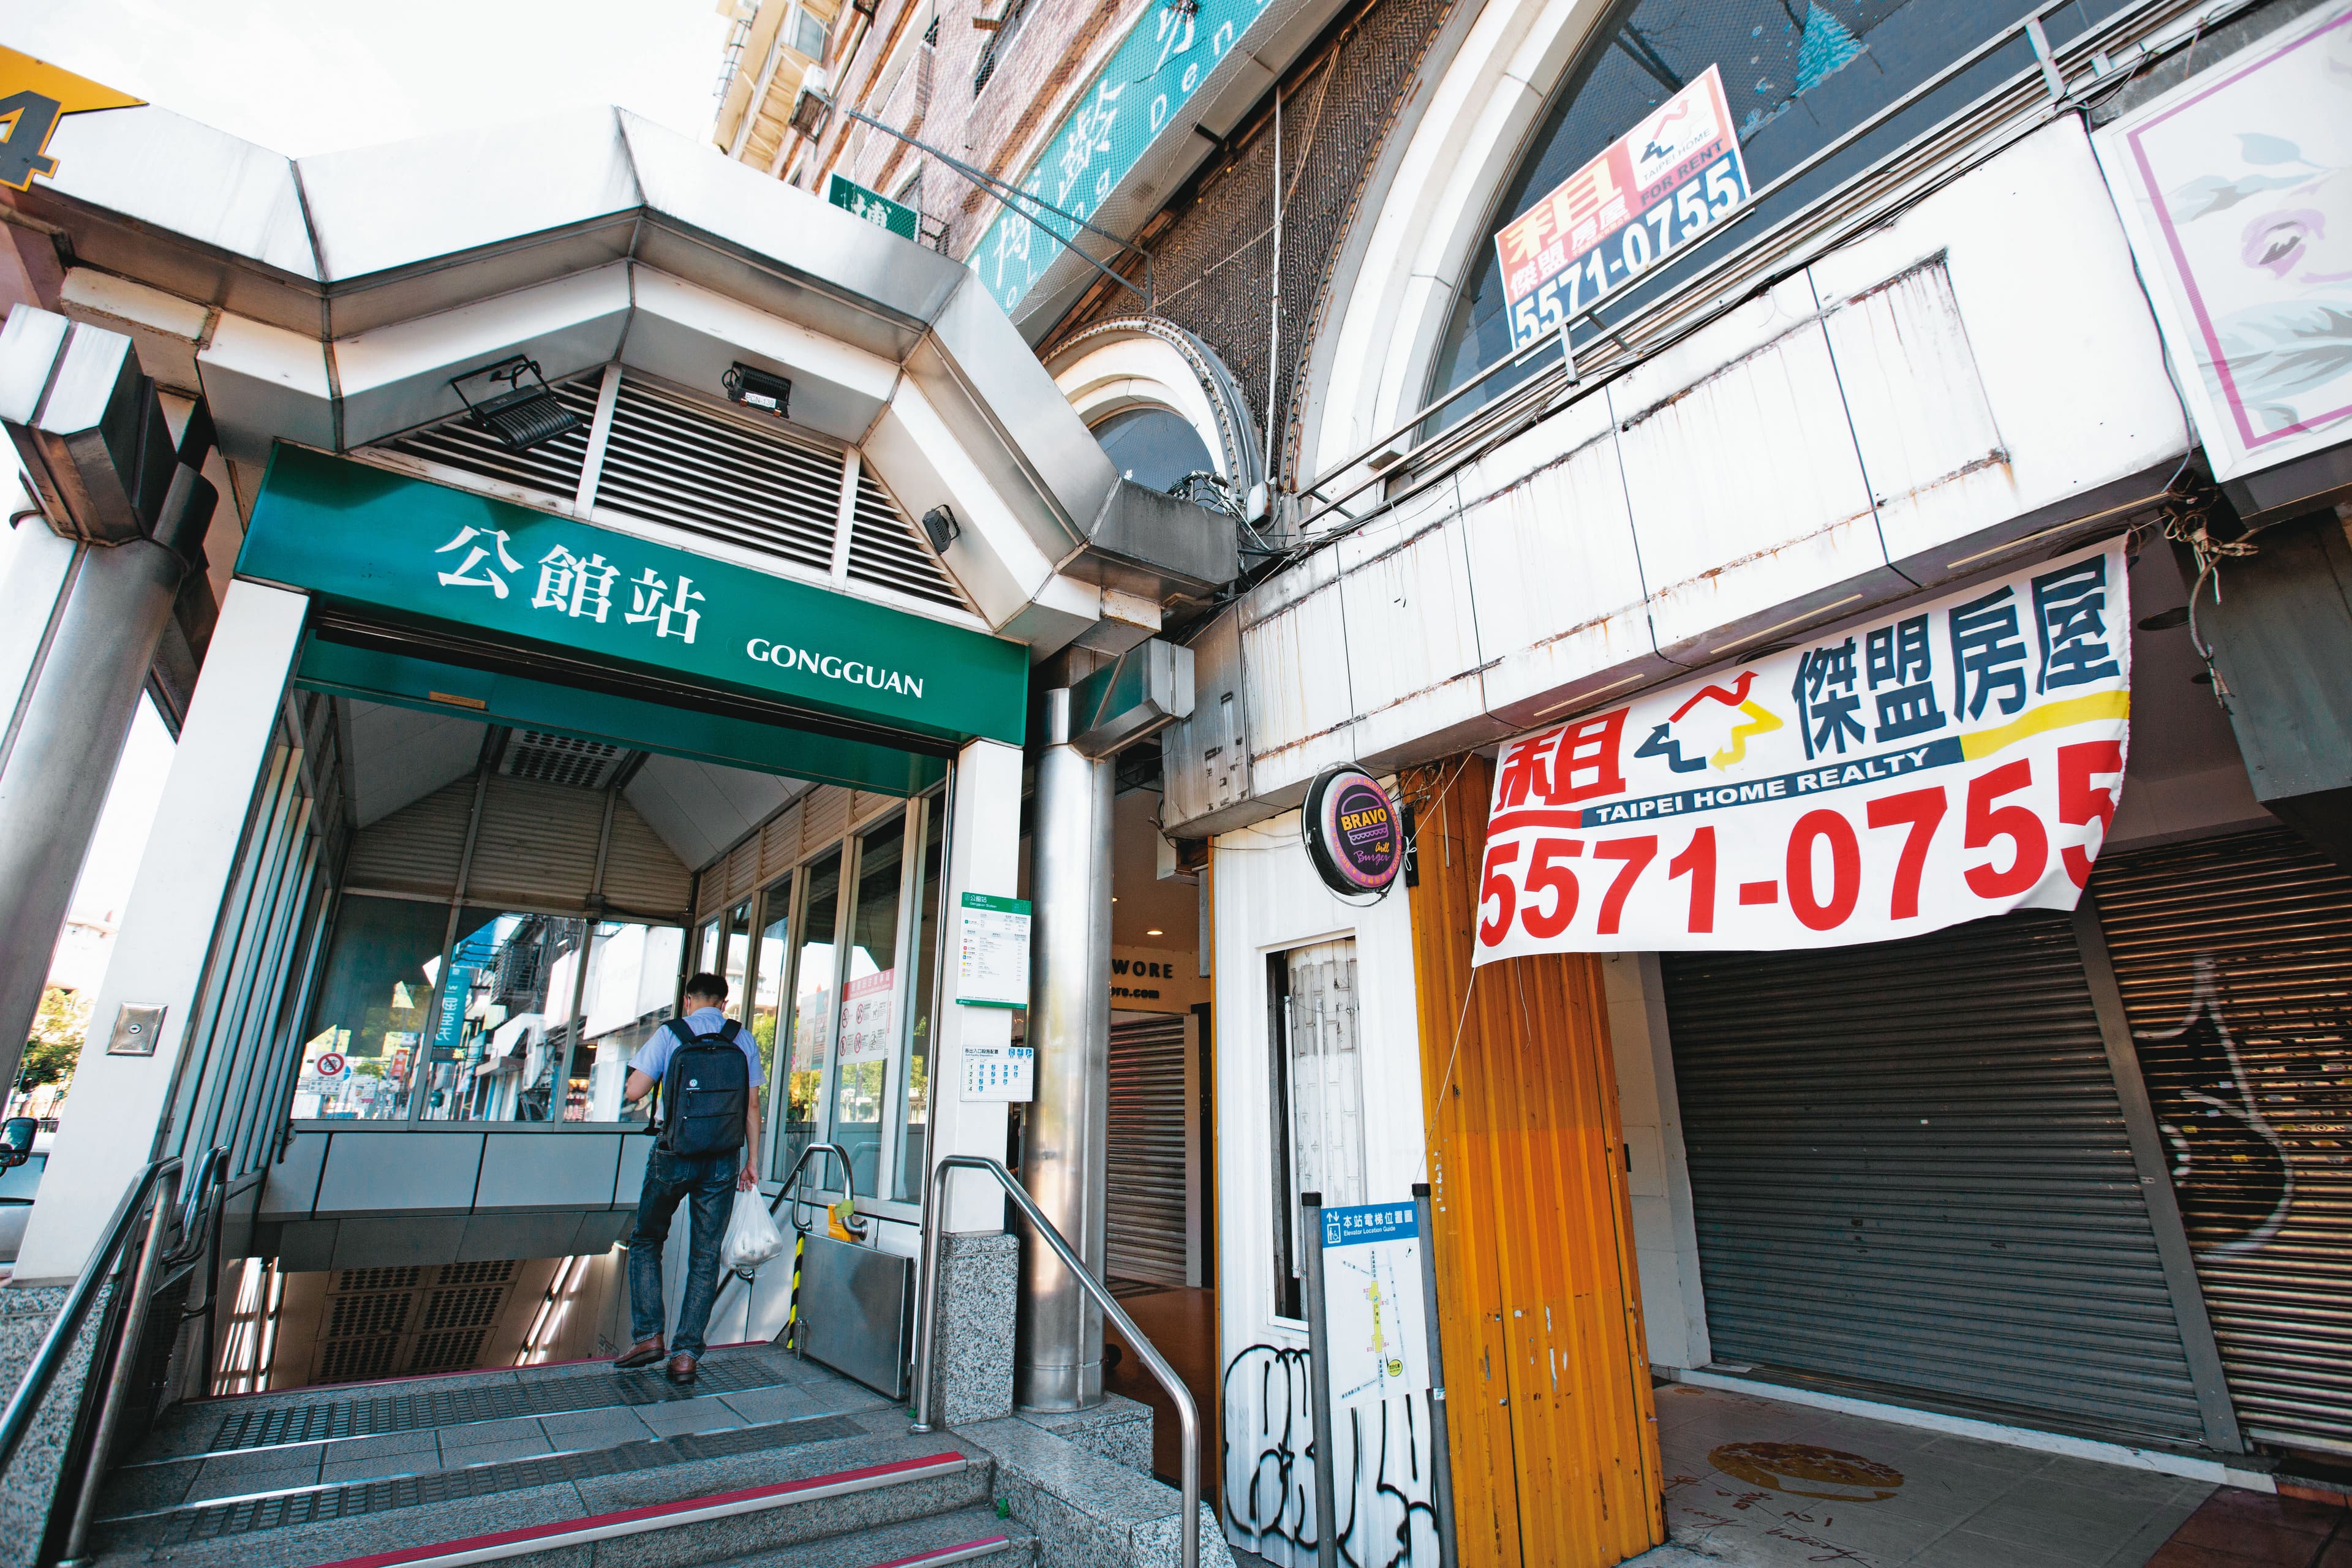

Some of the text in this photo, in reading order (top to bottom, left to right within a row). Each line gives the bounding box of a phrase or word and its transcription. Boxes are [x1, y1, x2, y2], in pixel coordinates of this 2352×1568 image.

[1150, 0, 1263, 133] Den
[0, 90, 60, 186] 4
[1640, 138, 1723, 206] FOR RENT
[1644, 127, 1711, 181] TAIPEI HOME
[1505, 157, 1623, 264] 租
[1510, 195, 1629, 300] 傑盟房屋
[1515, 157, 1740, 347] 5571-0755
[435, 524, 706, 644] 公館站
[746, 638, 924, 699] GONGGUAN
[1791, 552, 2121, 761] 傑盟房屋
[1341, 807, 1387, 831] BRAVO
[1363, 778, 1382, 795] BRAVO
[1596, 747, 1929, 825] TAIPEI HOME REALTY
[1353, 850, 1391, 865] Burger
[1480, 739, 2122, 948] 5571-0755
[1343, 1210, 1413, 1228] 本站電梯位置圖
[1765, 1528, 1869, 1562] bakery
